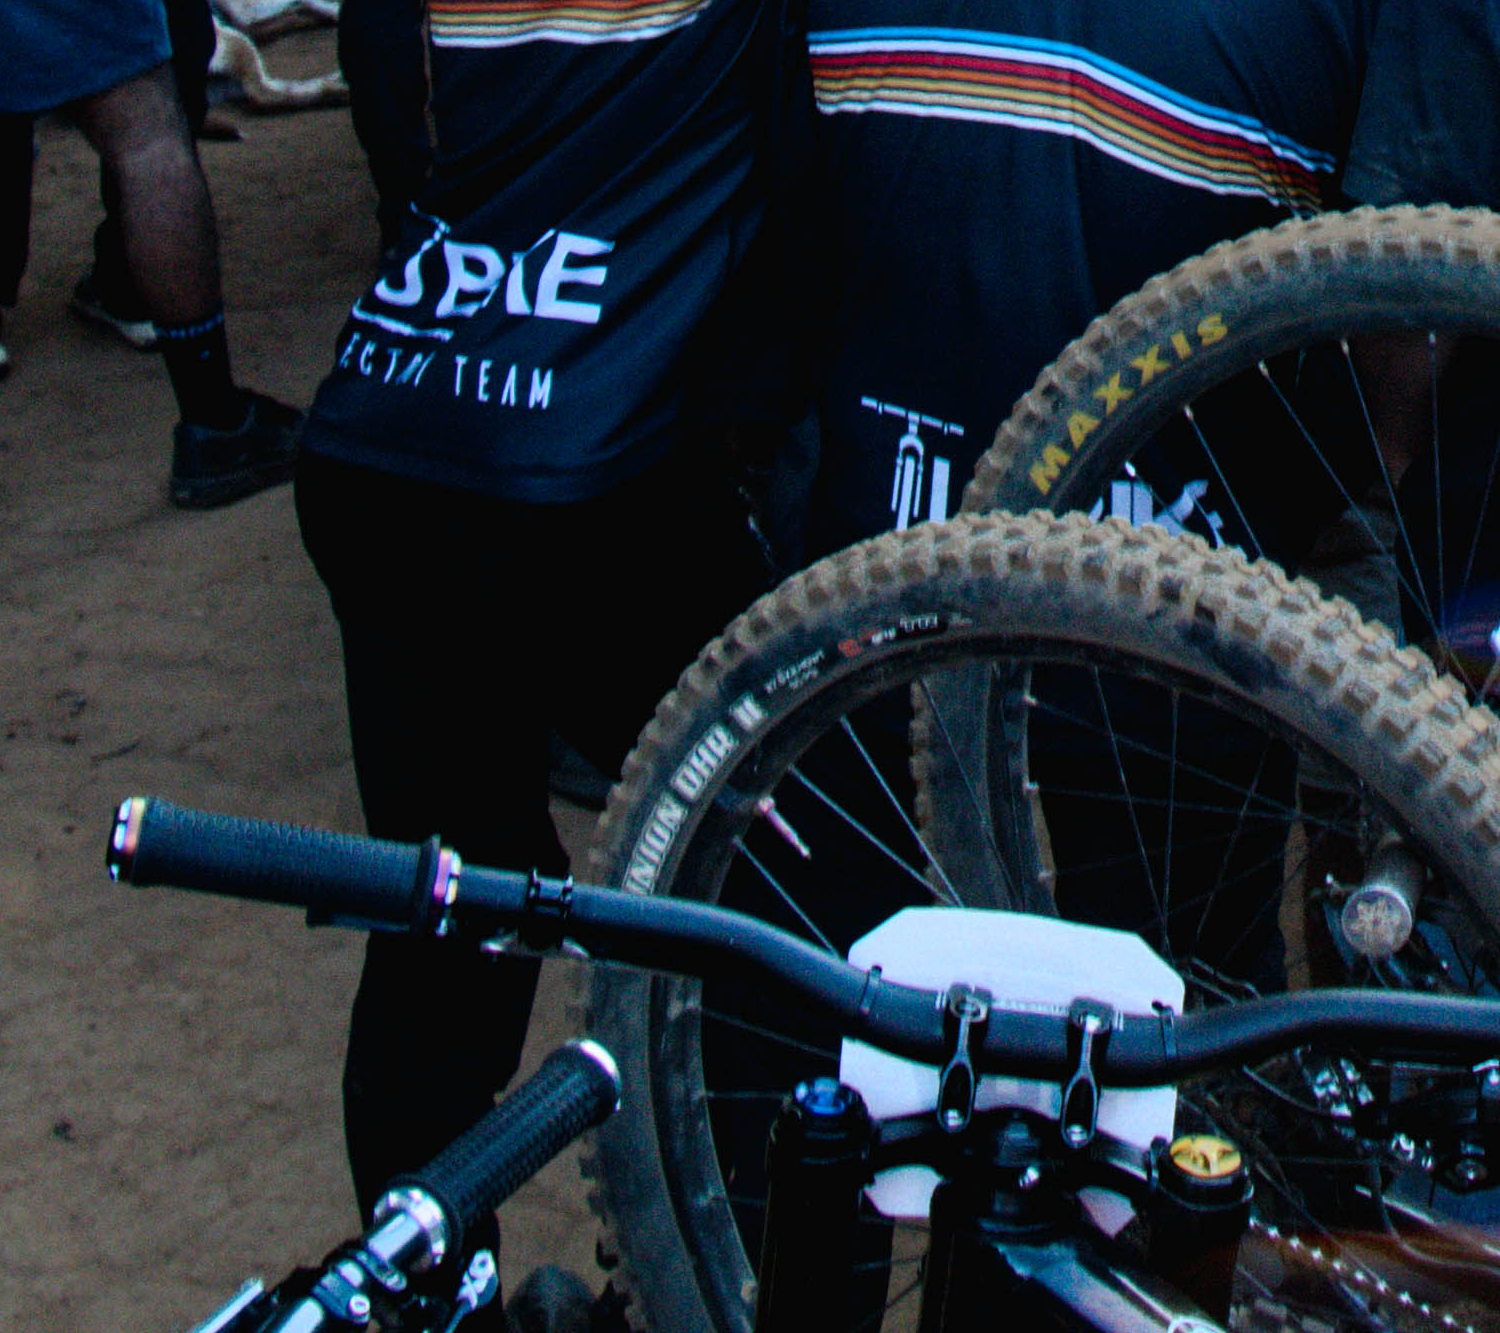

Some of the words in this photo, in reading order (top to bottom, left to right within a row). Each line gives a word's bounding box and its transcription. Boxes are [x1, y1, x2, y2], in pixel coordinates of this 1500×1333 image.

[455, 355, 553, 410] TEAM
[1029, 313, 1229, 498] MAXXIS
[670, 723, 739, 803] DHR
